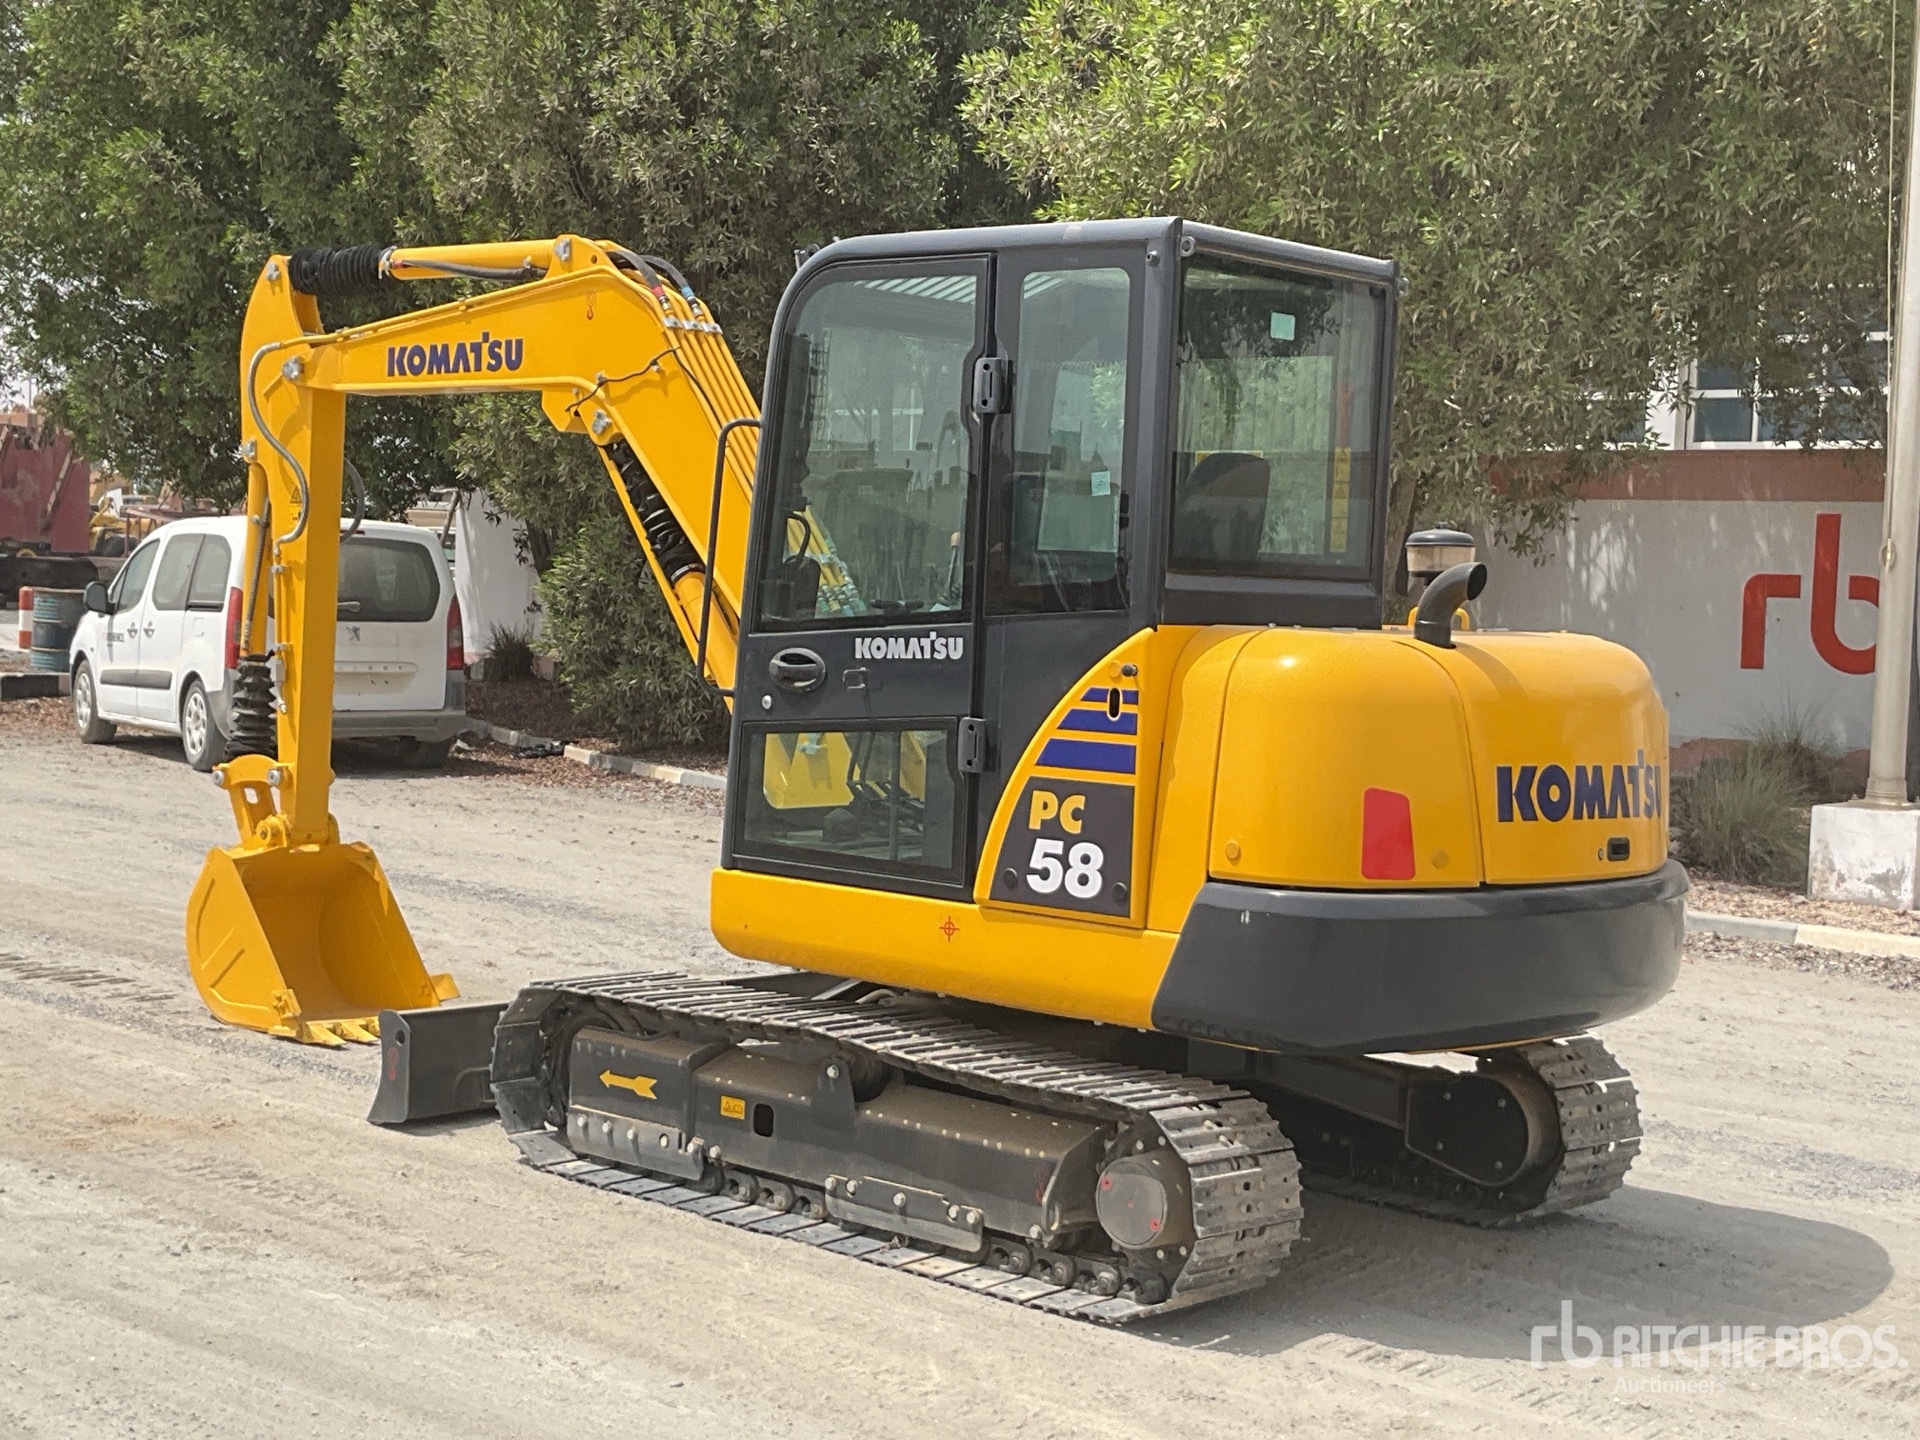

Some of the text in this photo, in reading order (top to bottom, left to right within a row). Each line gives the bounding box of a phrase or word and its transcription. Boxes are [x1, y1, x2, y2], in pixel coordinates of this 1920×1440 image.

[387, 331, 524, 377] KOMATSU
[855, 631, 964, 660] KOMATSU
[1028, 790, 1086, 834] PC
[1026, 838, 1104, 898] 58
